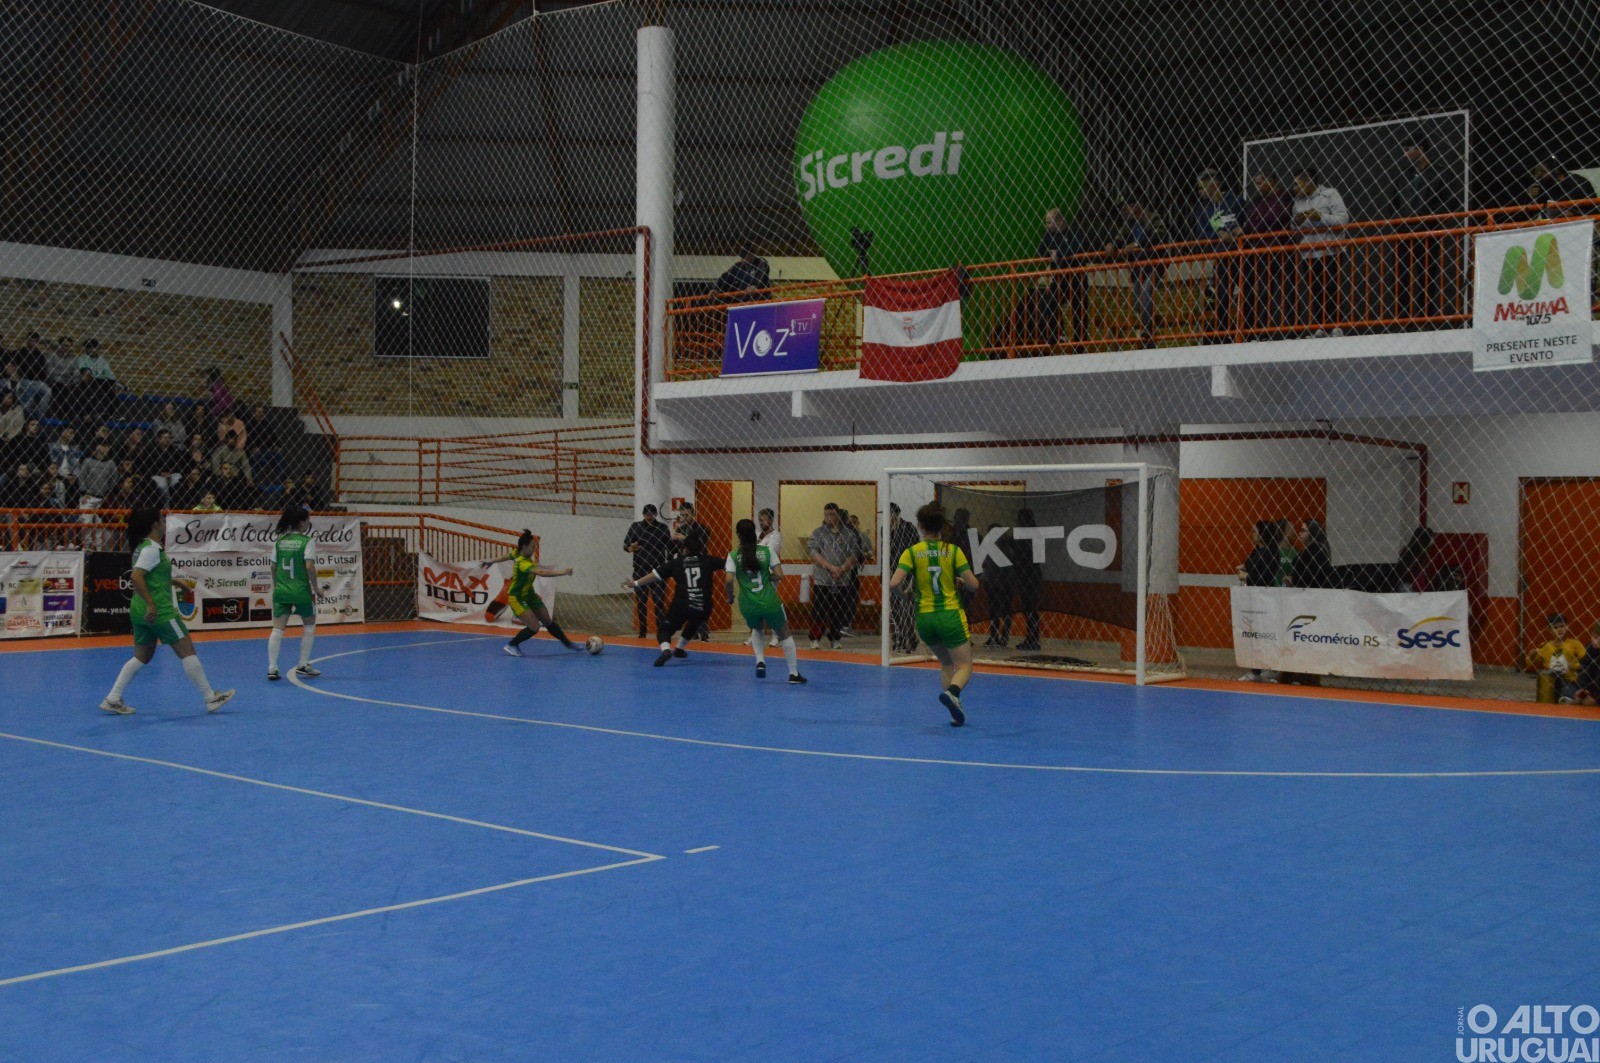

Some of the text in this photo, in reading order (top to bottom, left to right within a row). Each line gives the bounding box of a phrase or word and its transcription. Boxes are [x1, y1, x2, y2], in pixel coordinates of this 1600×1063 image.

[800, 131, 964, 201] Sicredi
[1494, 297, 1569, 322] MÁXIMA
[797, 321, 807, 332] TV
[1486, 335, 1578, 352] PRESENTE NESTE
[1510, 350, 1554, 363] EVENTO
[175, 519, 353, 545] Somos todo odeio
[968, 524, 1118, 576] KTO
[171, 556, 233, 568] Apoiadores
[282, 557, 295, 580] 4
[327, 555, 357, 565] Futsal
[94, 576, 134, 593] yesbe
[216, 578, 247, 588] Sicredi
[424, 566, 490, 597] MAX
[747, 570, 764, 593] 3
[928, 566, 942, 594] 7
[425, 583, 489, 605] 1000
[206, 604, 238, 617] yesbet
[1293, 631, 1380, 647] Fecomércio RS
